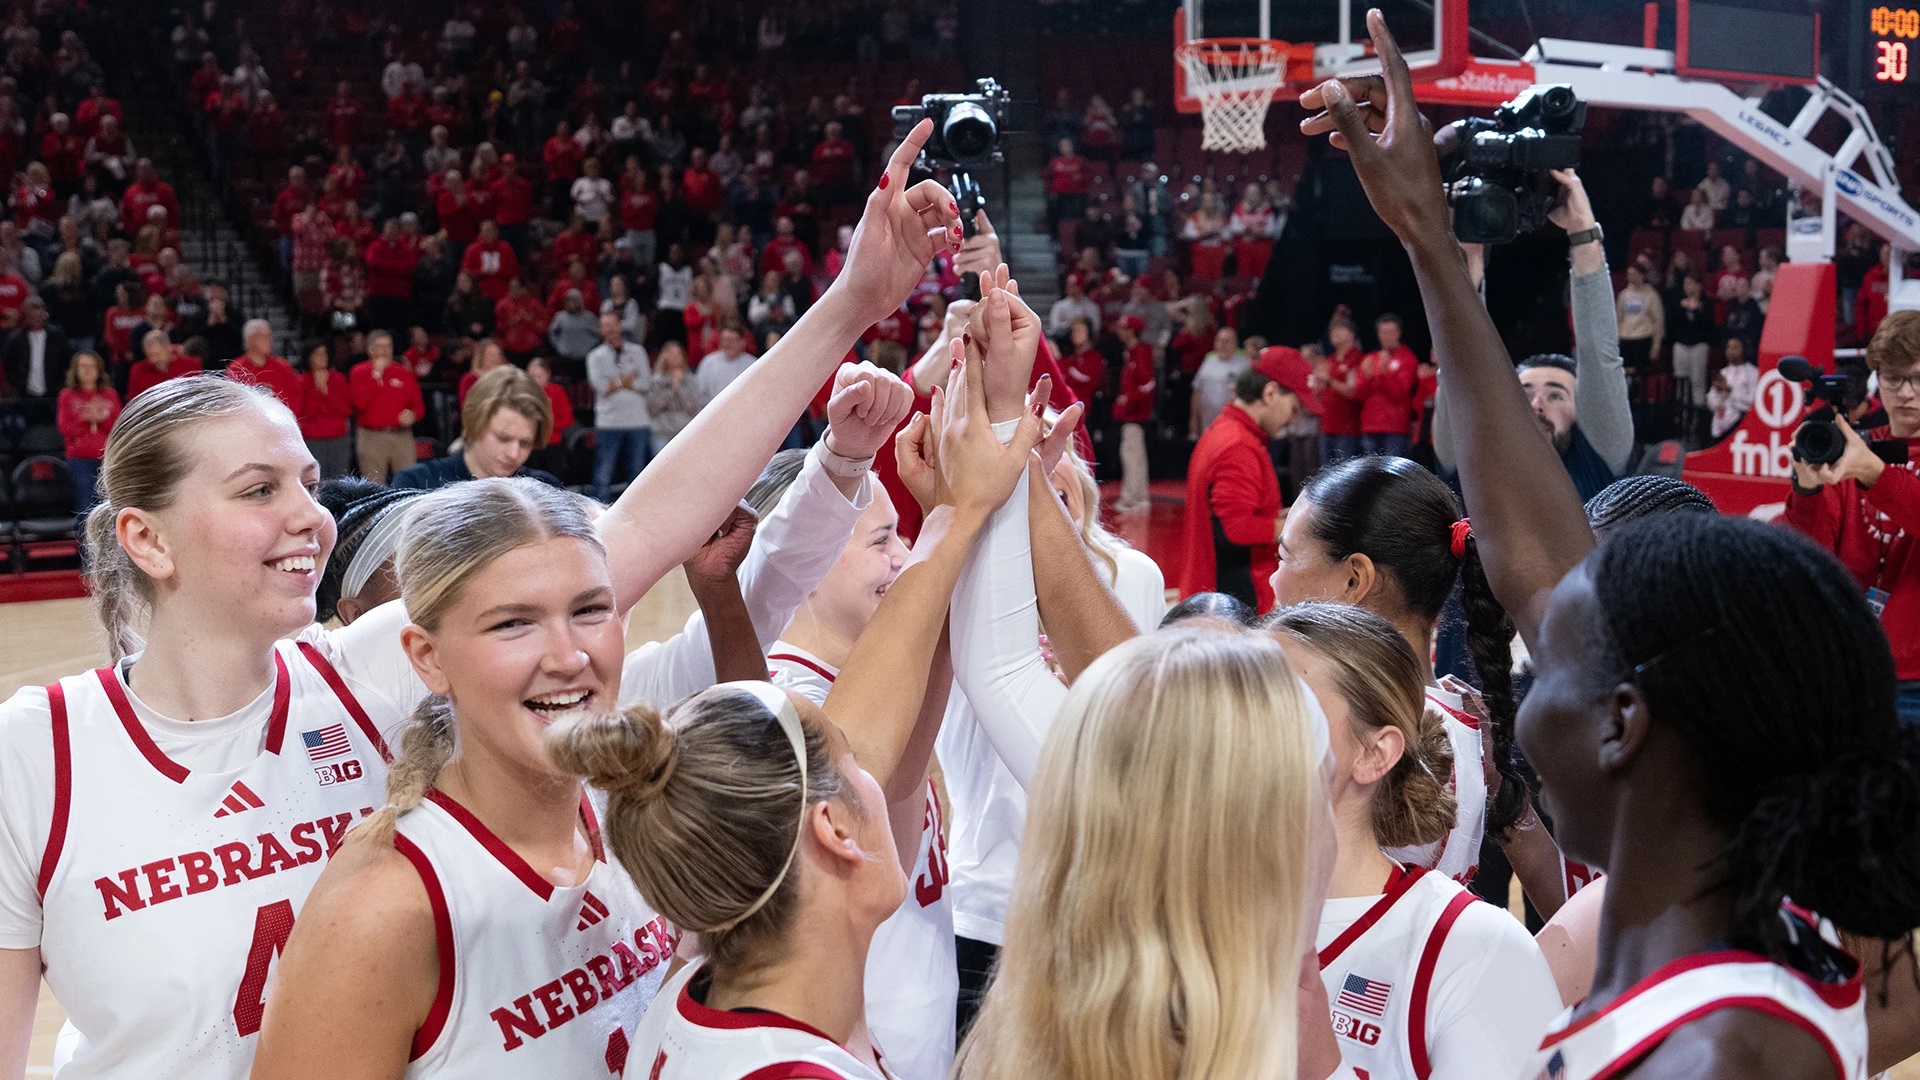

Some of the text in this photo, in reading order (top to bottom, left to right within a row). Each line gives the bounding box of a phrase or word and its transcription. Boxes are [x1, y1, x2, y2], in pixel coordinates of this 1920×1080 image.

[1871, 6, 1920, 39] 10:00
[1876, 41, 1908, 82] 30
[1738, 111, 1793, 146] LEGACY
[1863, 189, 1915, 227] SPORTS
[94, 807, 374, 922] NEBRASK
[489, 914, 683, 1053] NEBRASK
